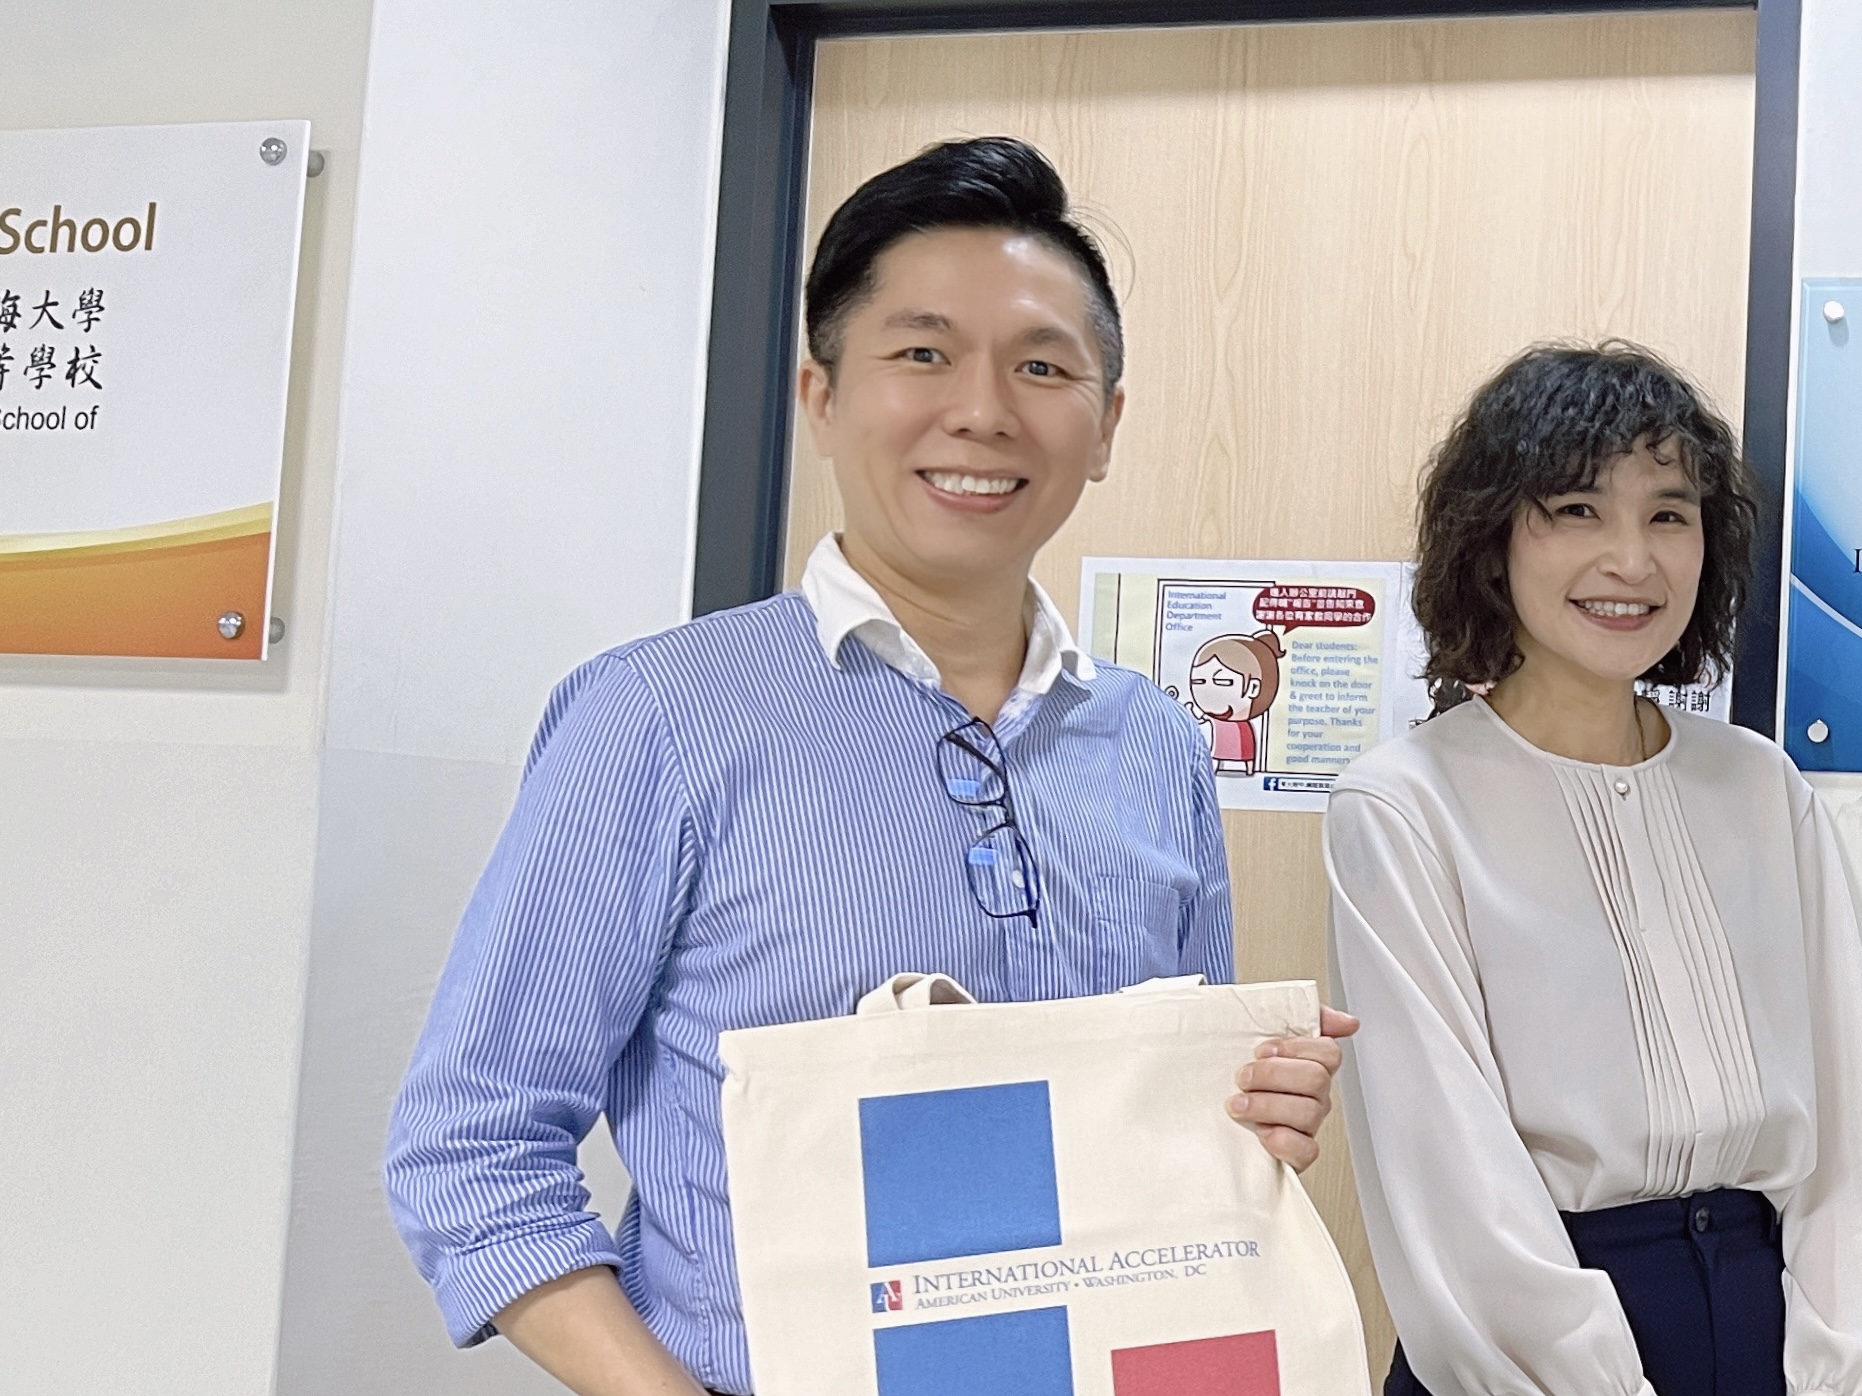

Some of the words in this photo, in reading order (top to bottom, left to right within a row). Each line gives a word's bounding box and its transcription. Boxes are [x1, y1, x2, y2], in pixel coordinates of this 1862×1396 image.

[0, 202, 157, 254] School
[0, 406, 66, 430] chool
[75, 405, 99, 430] of
[1168, 590, 1226, 600] International
[1167, 600, 1212, 609] Education
[1166, 611, 1222, 622] Department
[1165, 622, 1193, 631] Office
[1292, 641, 1313, 650] Dear
[1291, 653, 1321, 662] Before
[1323, 655, 1361, 665] entering
[1363, 655, 1378, 664] the
[1321, 667, 1350, 677] please
[1290, 678, 1317, 688] knock
[1333, 680, 1349, 688] the
[1351, 680, 1372, 689] door
[1326, 692, 1335, 700] to
[1337, 692, 1368, 701] inform
[1288, 704, 1303, 712] the
[1306, 705, 1340, 713] teacher
[1342, 705, 1352, 714] of
[1354, 708, 1376, 717] your
[1330, 717, 1363, 727] Thanks
[1288, 728, 1300, 737] for
[1302, 731, 1323, 740] your
[1286, 743, 1341, 752] cooperation
[1343, 743, 1361, 752] and
[1286, 755, 1309, 765] good
[913, 1256, 1103, 1294] INTERNATIONAL
[1109, 1240, 1260, 1271] ACCELERATOR
[915, 1292, 988, 1311] AMERICAN
[991, 1281, 1070, 1301] UNIVERSITY
[1184, 1264, 1207, 1277] DC
